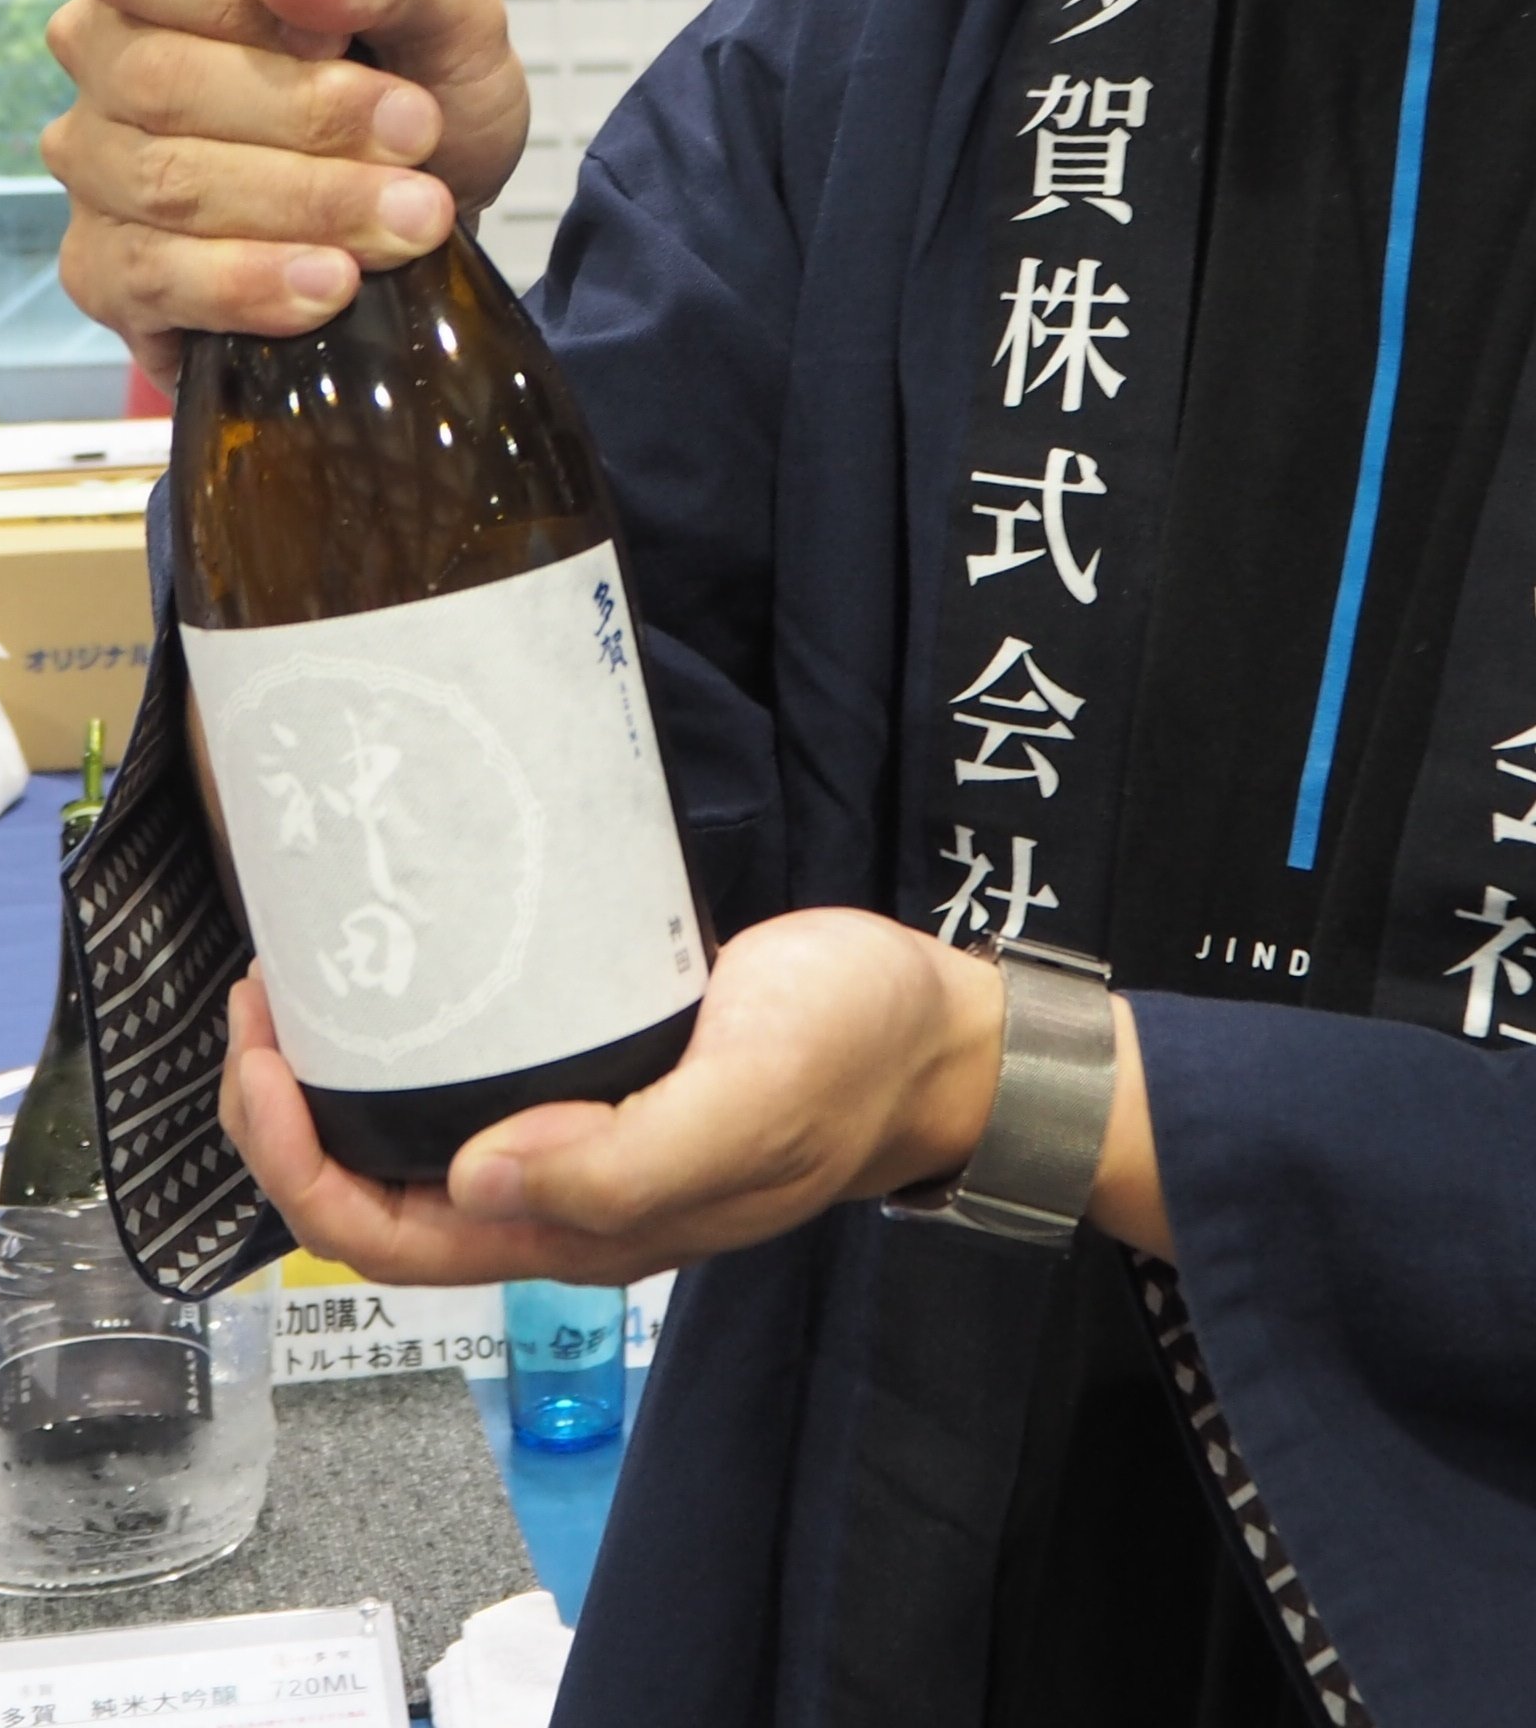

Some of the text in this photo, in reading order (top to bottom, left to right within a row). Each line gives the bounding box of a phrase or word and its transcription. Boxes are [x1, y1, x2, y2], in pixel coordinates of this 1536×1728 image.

[593, 582, 628, 674] 多賀
[1194, 933, 1311, 977] JIND
[275, 1296, 396, 1337] 加購入
[1, 1703, 56, 1728] 多賀
[91, 1685, 237, 1719] 純米大吟醸
[270, 1673, 367, 1700] 720ML
